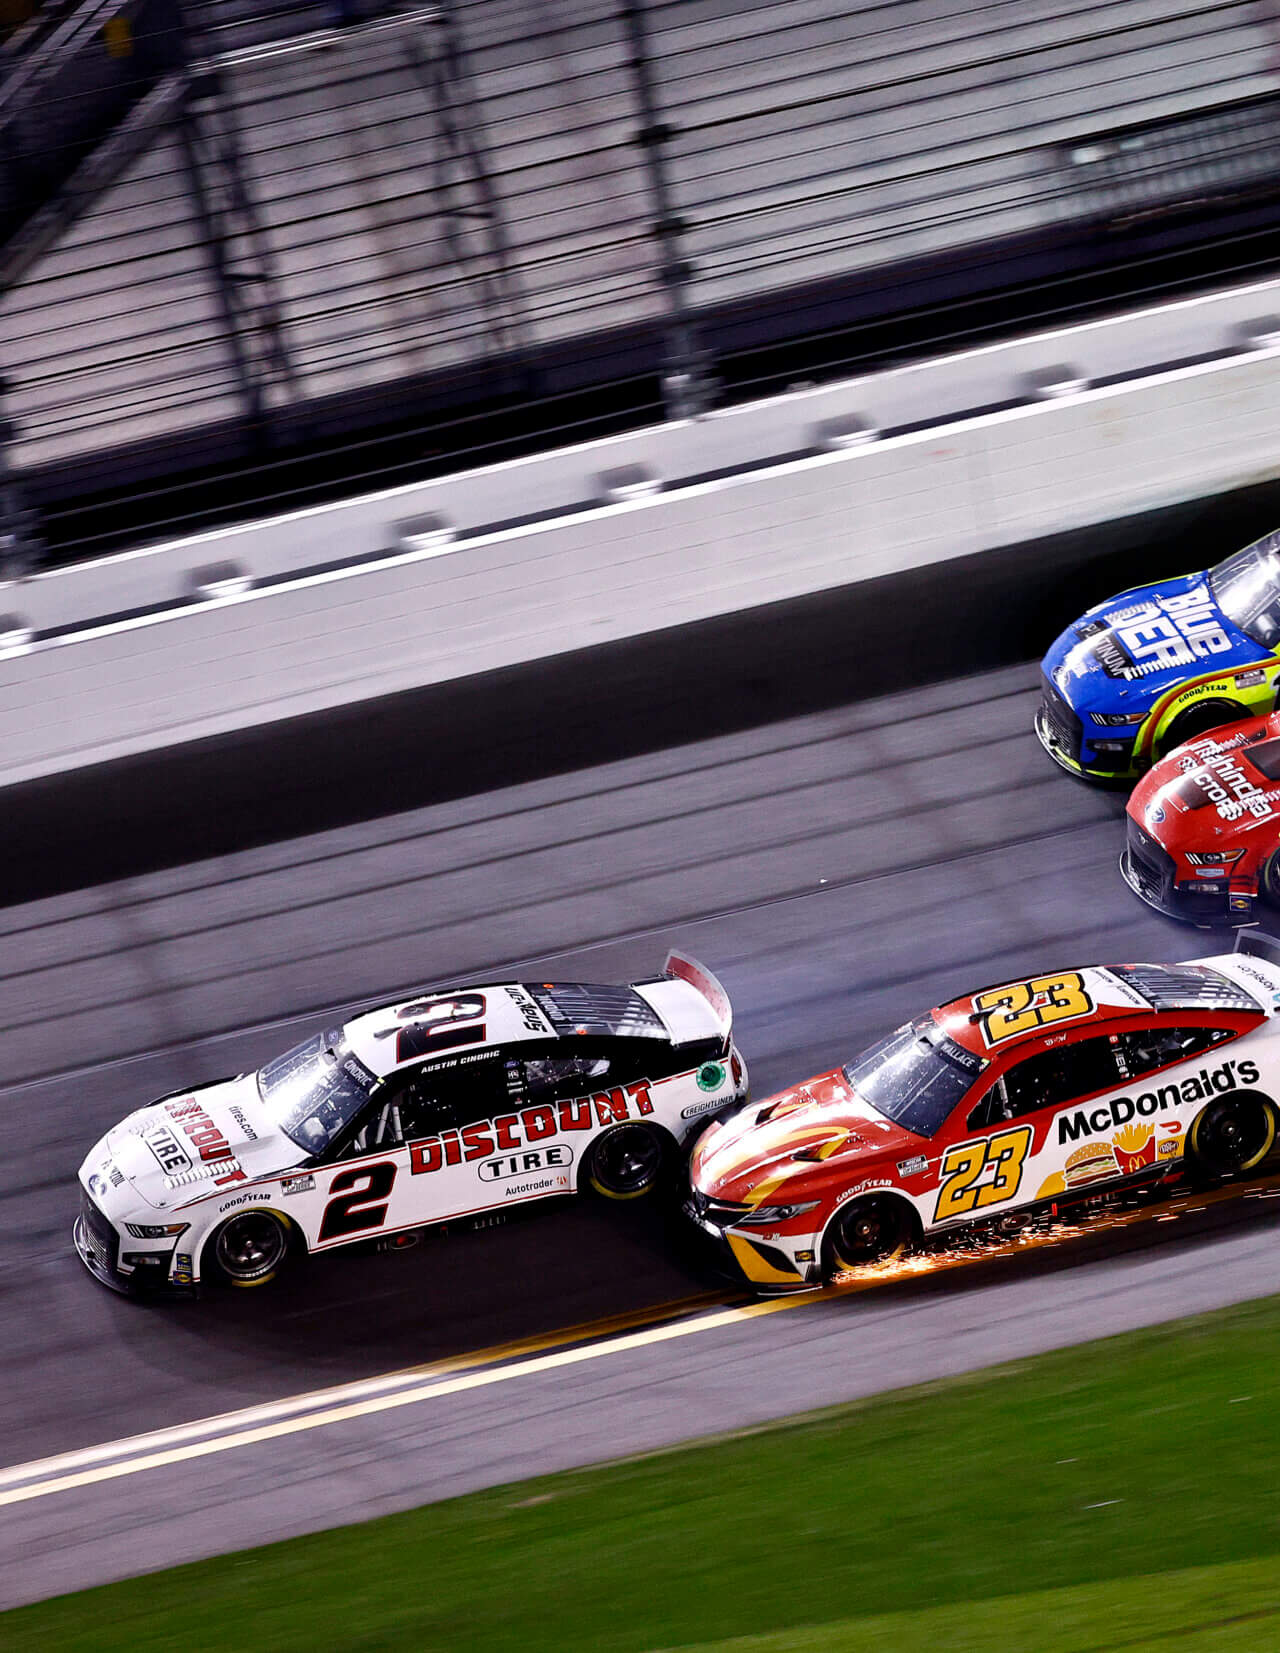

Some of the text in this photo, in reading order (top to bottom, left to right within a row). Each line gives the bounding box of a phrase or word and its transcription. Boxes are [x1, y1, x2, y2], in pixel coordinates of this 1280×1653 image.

[1080, 622, 1129, 677] PLTINUM
[1179, 684, 1228, 704] GOODYEAR
[975, 969, 1095, 1046] 23
[396, 992, 487, 1065] 2
[421, 1050, 500, 1074] AUSTIN CINDRIC
[941, 1041, 976, 1068] WALLACE
[686, 1095, 734, 1116] FREIGHTLINER
[1057, 1060, 1260, 1146] McDonald's
[407, 1078, 655, 1177] DISCOUNT
[150, 1126, 188, 1171] TIRE
[486, 1148, 564, 1179] TIRE
[505, 1178, 554, 1197] Autotrader
[836, 1178, 893, 1204] GOODYEAR
[932, 1125, 1033, 1224] 23
[219, 1192, 272, 1213] GOODYEAR
[316, 1160, 398, 1244] 2
